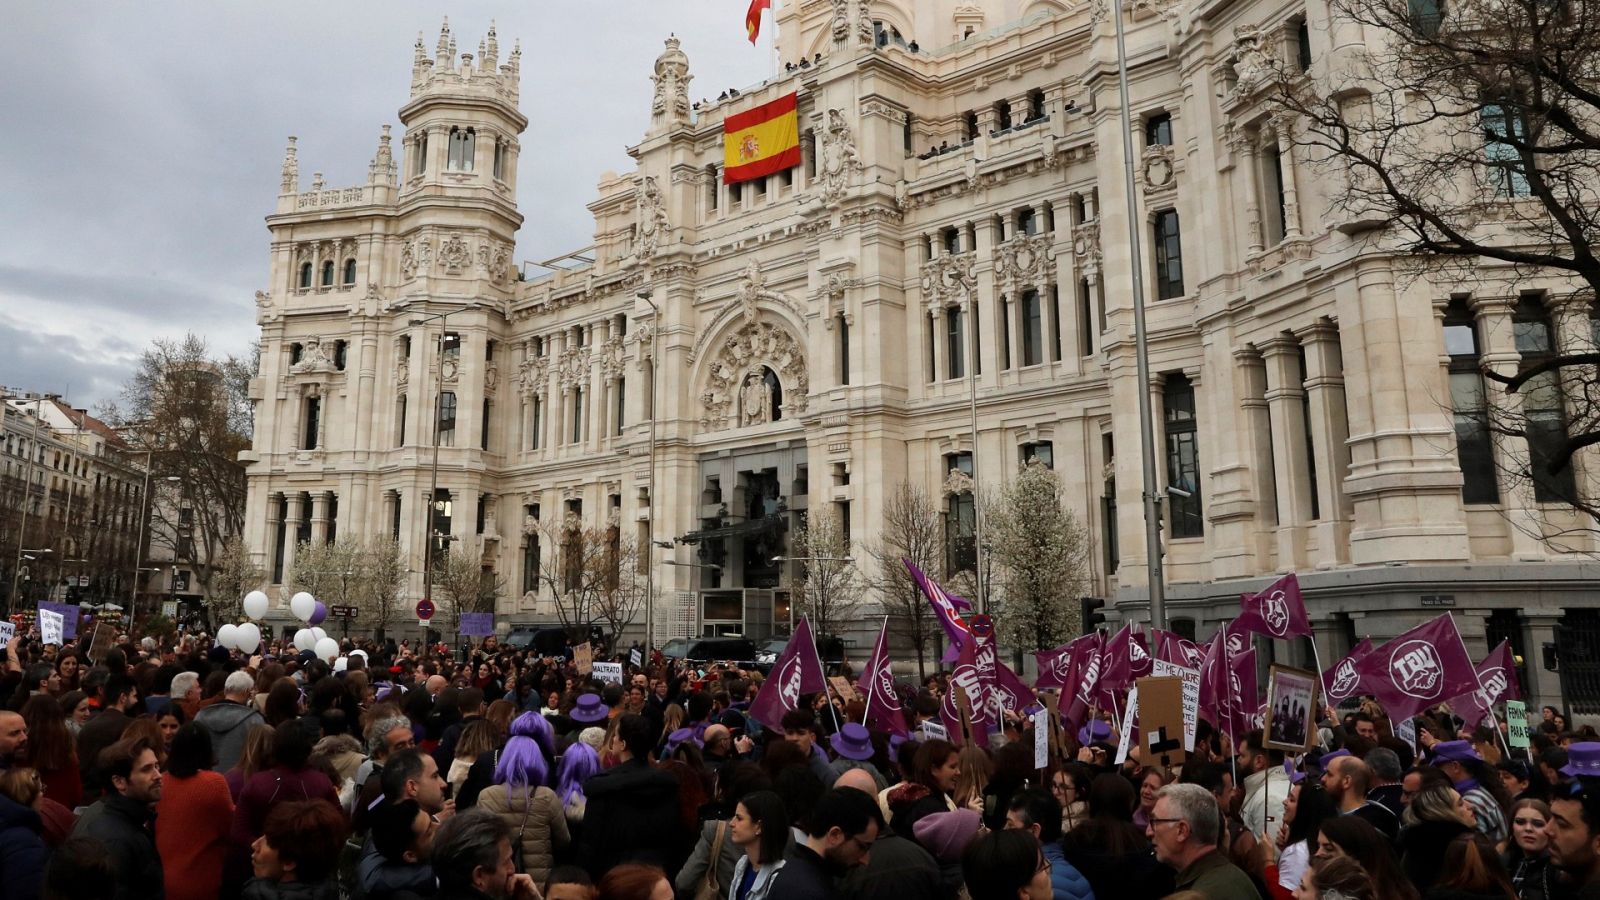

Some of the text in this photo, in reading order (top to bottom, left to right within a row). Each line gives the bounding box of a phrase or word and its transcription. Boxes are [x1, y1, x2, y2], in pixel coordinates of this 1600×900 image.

[592, 665, 620, 673] MALTRATO
[1156, 661, 1164, 671] SI
[1165, 665, 1175, 676] ME
[956, 669, 984, 716] UGT
[1510, 725, 1525, 738] PARA
